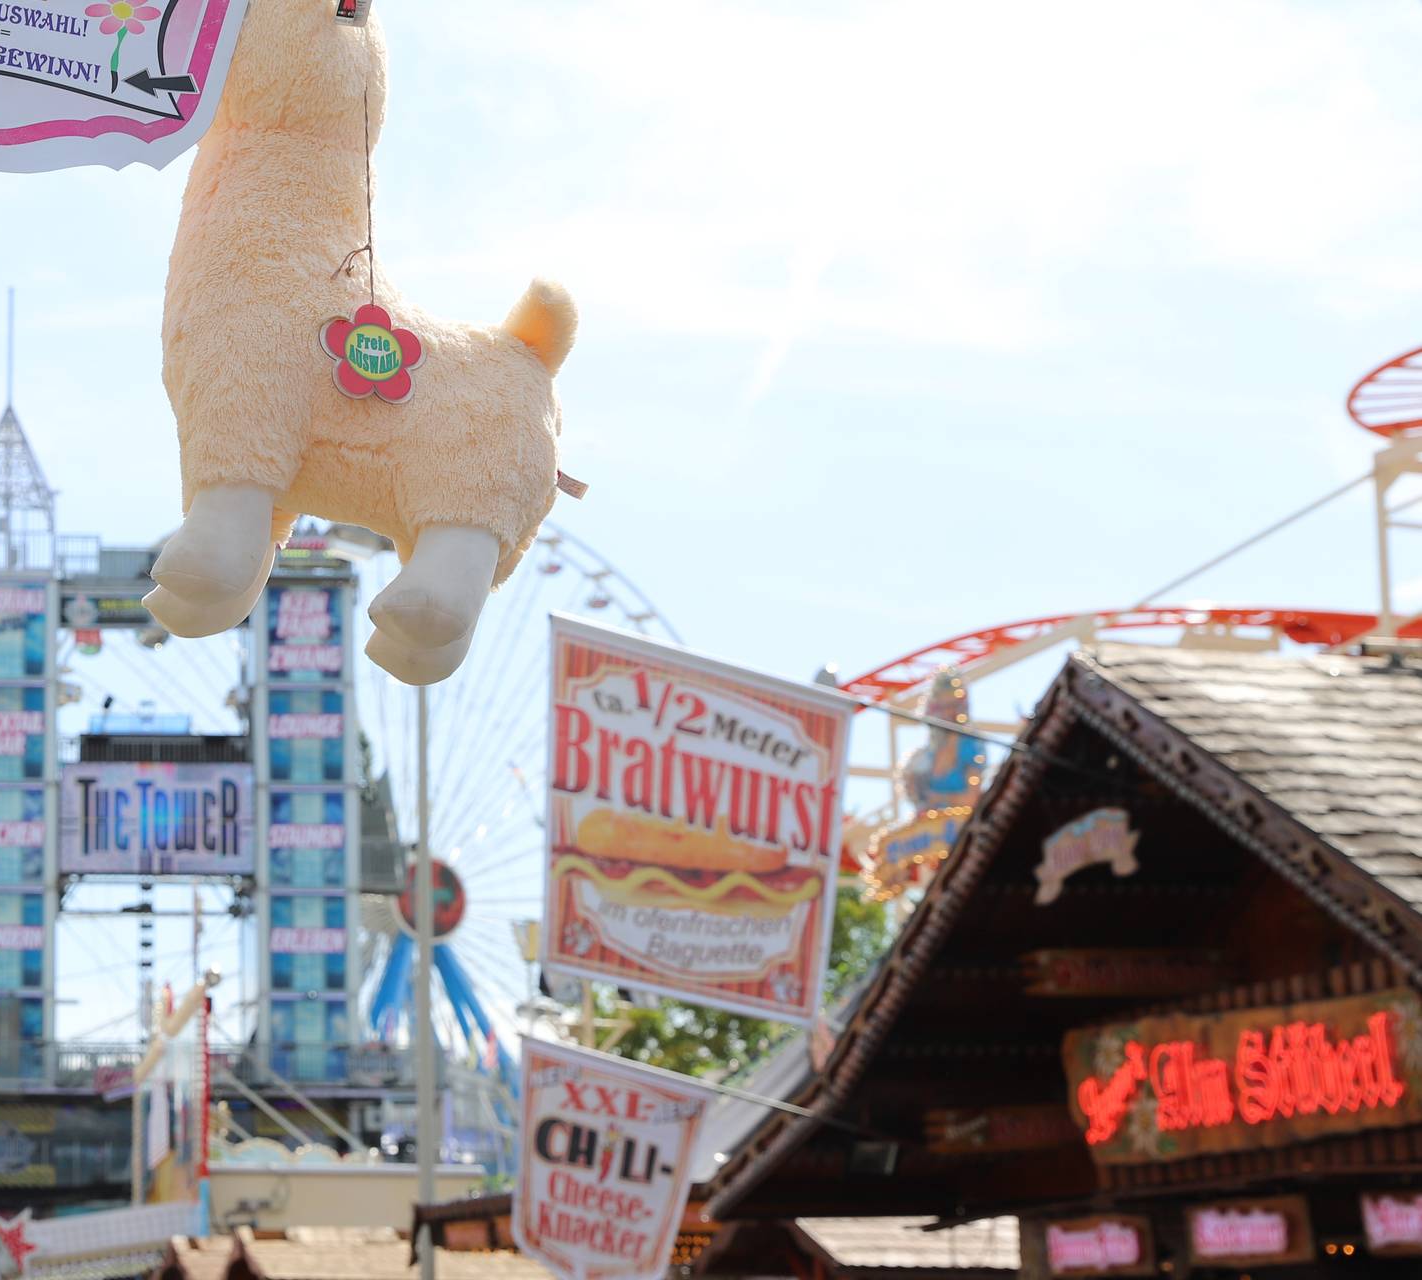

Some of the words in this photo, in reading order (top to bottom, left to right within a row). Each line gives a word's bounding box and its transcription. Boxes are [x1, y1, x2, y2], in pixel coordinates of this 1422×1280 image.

[348, 344, 399, 374] AUSWAHL
[356, 333, 391, 352] Freie
[268, 713, 344, 739] LOUNGE
[633, 669, 707, 735] 1/2
[711, 712, 809, 767] Meter
[553, 703, 839, 857] Bratwurst
[647, 932, 764, 968] Baguette
[537, 1201, 649, 1262] Knacker
